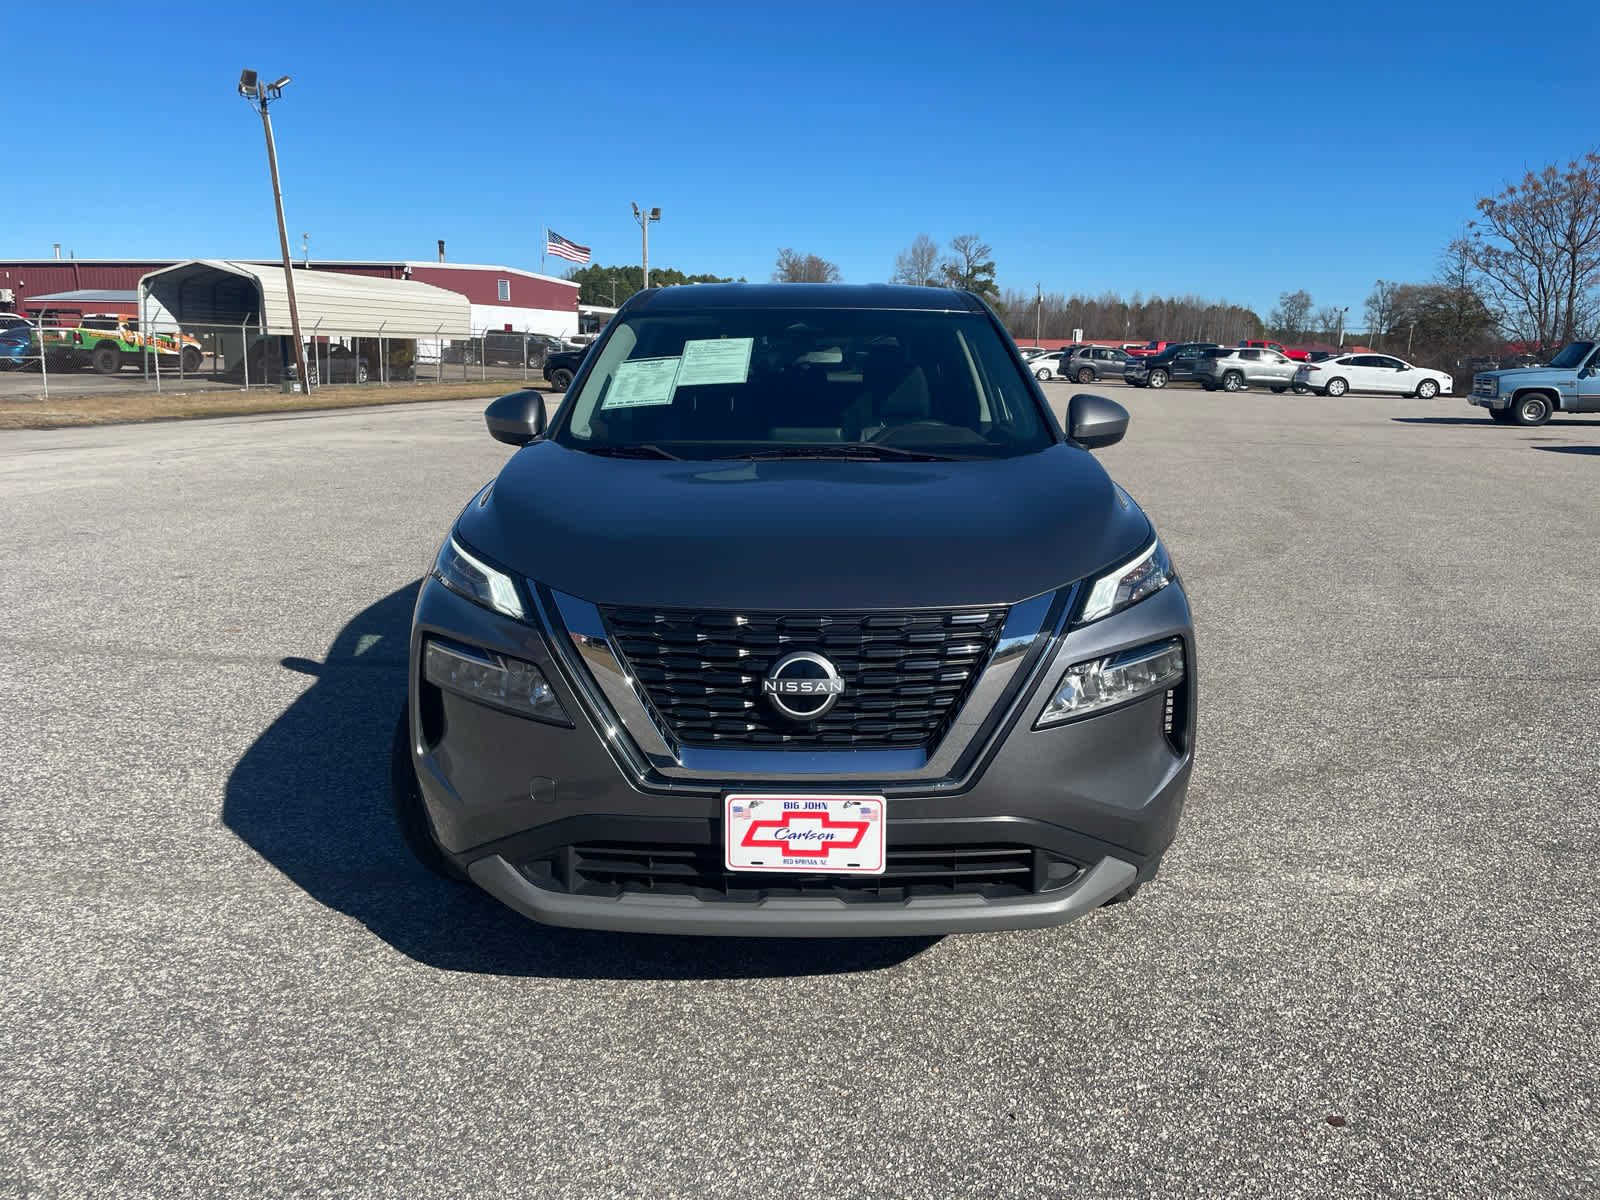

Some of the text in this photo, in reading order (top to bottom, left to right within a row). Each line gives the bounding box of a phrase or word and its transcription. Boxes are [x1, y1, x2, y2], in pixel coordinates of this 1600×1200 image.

[764, 681, 842, 692] NISSAN
[783, 801, 828, 810] BIG JOHN
[774, 828, 834, 840] Carlson
